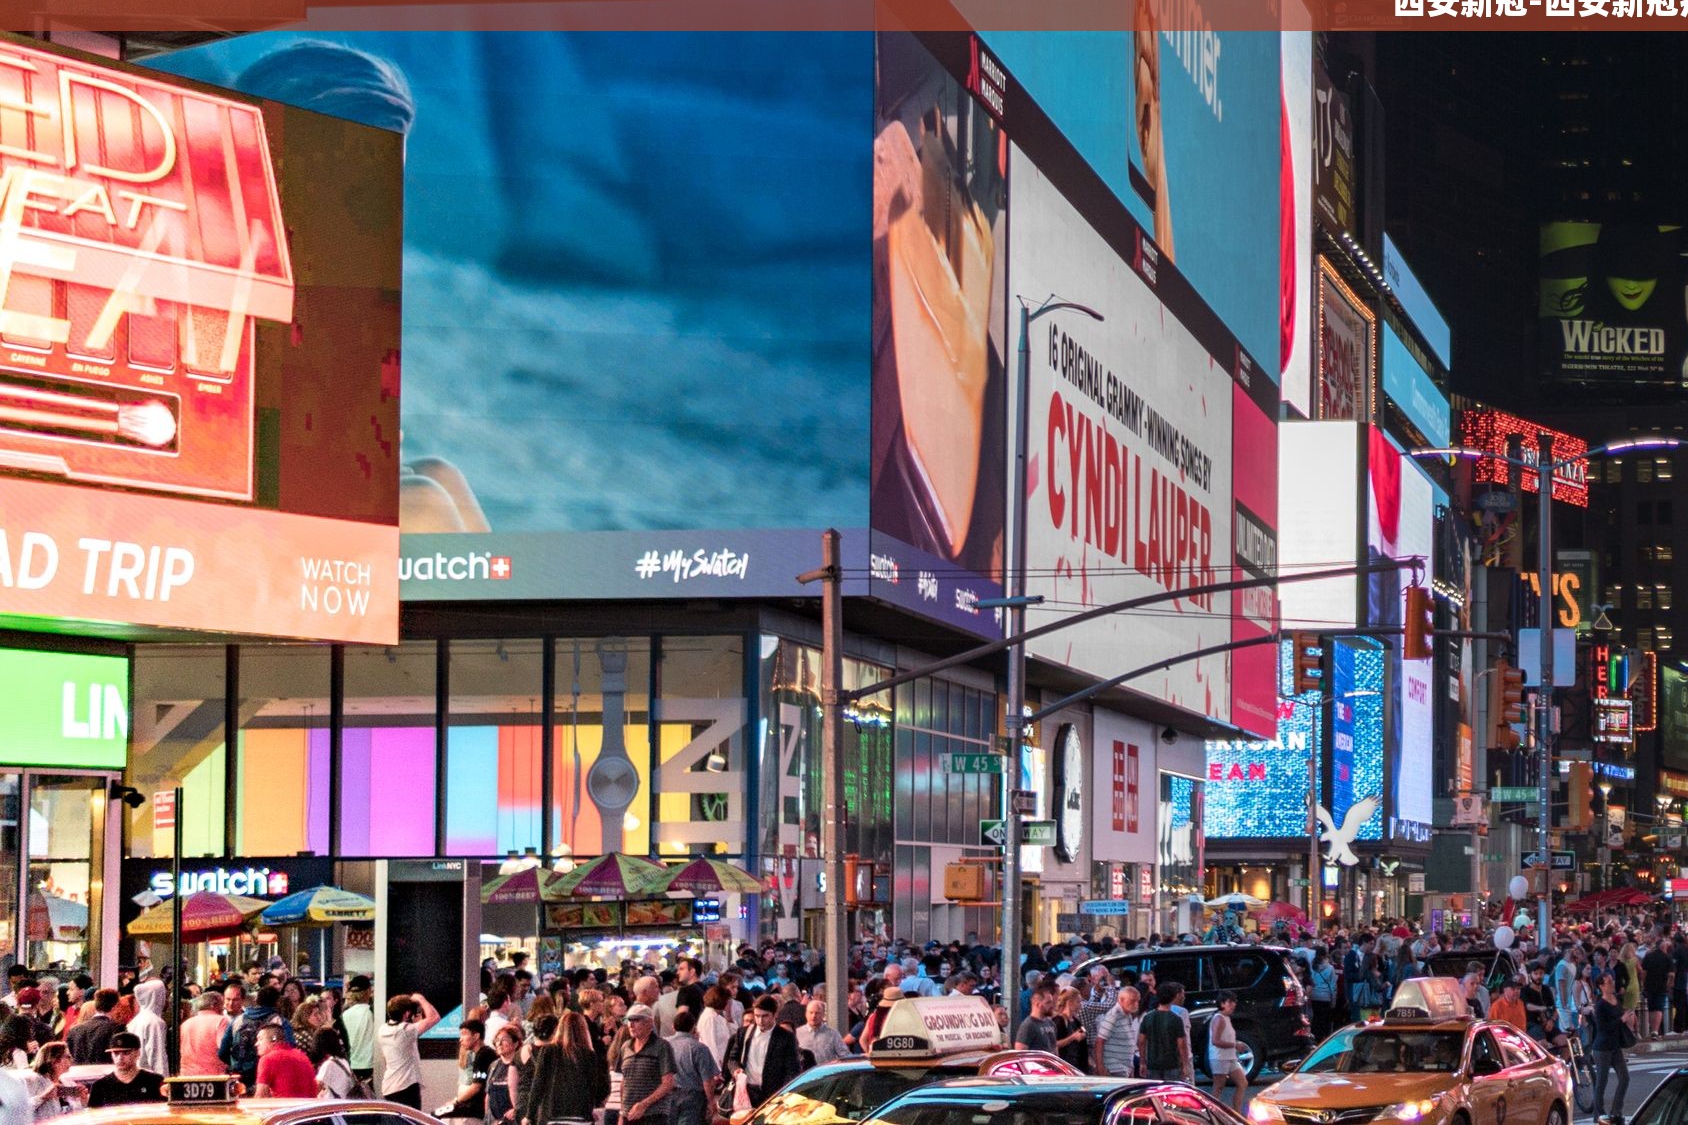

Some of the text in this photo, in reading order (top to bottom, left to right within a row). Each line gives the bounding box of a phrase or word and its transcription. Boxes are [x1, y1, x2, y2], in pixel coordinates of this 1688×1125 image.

[1560, 319, 1666, 355] WICKED
[1049, 321, 1059, 372] 16
[1061, 331, 1105, 410] ORIGINAL
[1180, 433, 1203, 488] SONGS
[1203, 454, 1213, 495] BY
[1047, 390, 1214, 615] CYNDI LAUPER
[78, 538, 195, 602] TRIP
[302, 556, 371, 587] WATCH
[302, 586, 371, 617] NOW
[954, 756, 989, 771] W 45
[1514, 790, 1527, 799] 45
[1023, 827, 1047, 839] WAY
[432, 861, 462, 870] LinkNYC
[978, 1011, 995, 1027] DAY
[887, 1037, 914, 1049] 9G80
[182, 1081, 215, 1100] 3D79
